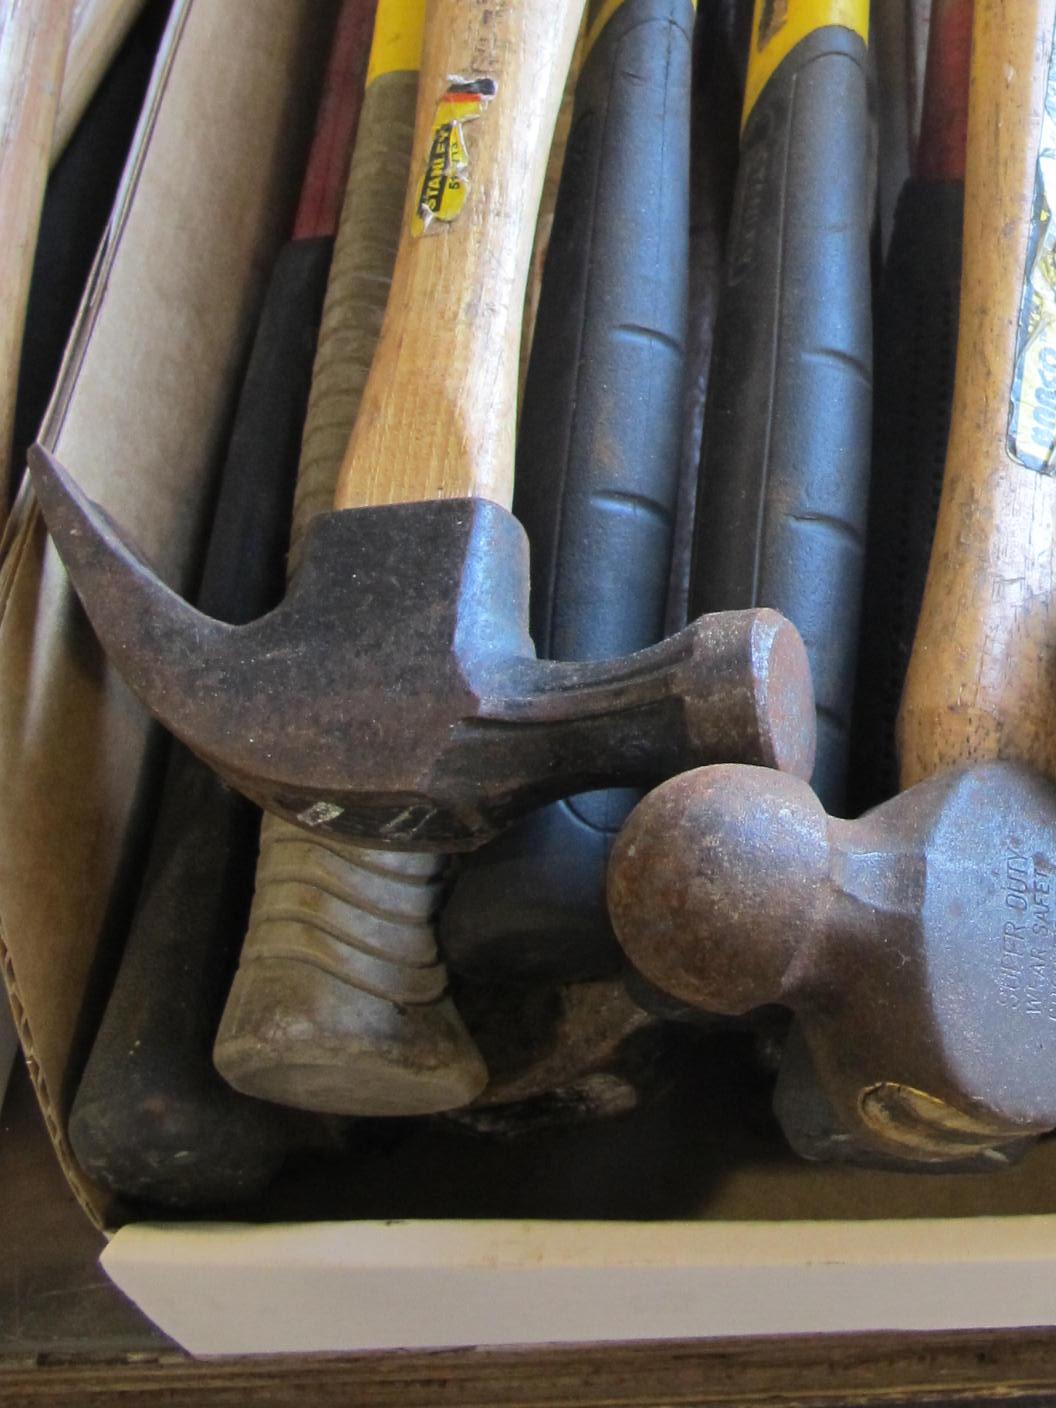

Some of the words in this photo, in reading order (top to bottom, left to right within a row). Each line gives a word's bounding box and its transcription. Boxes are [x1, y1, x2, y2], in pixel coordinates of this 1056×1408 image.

[426, 129, 450, 210] STANLEY
[1005, 845, 1028, 912] DUTY
[1032, 853, 1051, 937] SAFET
